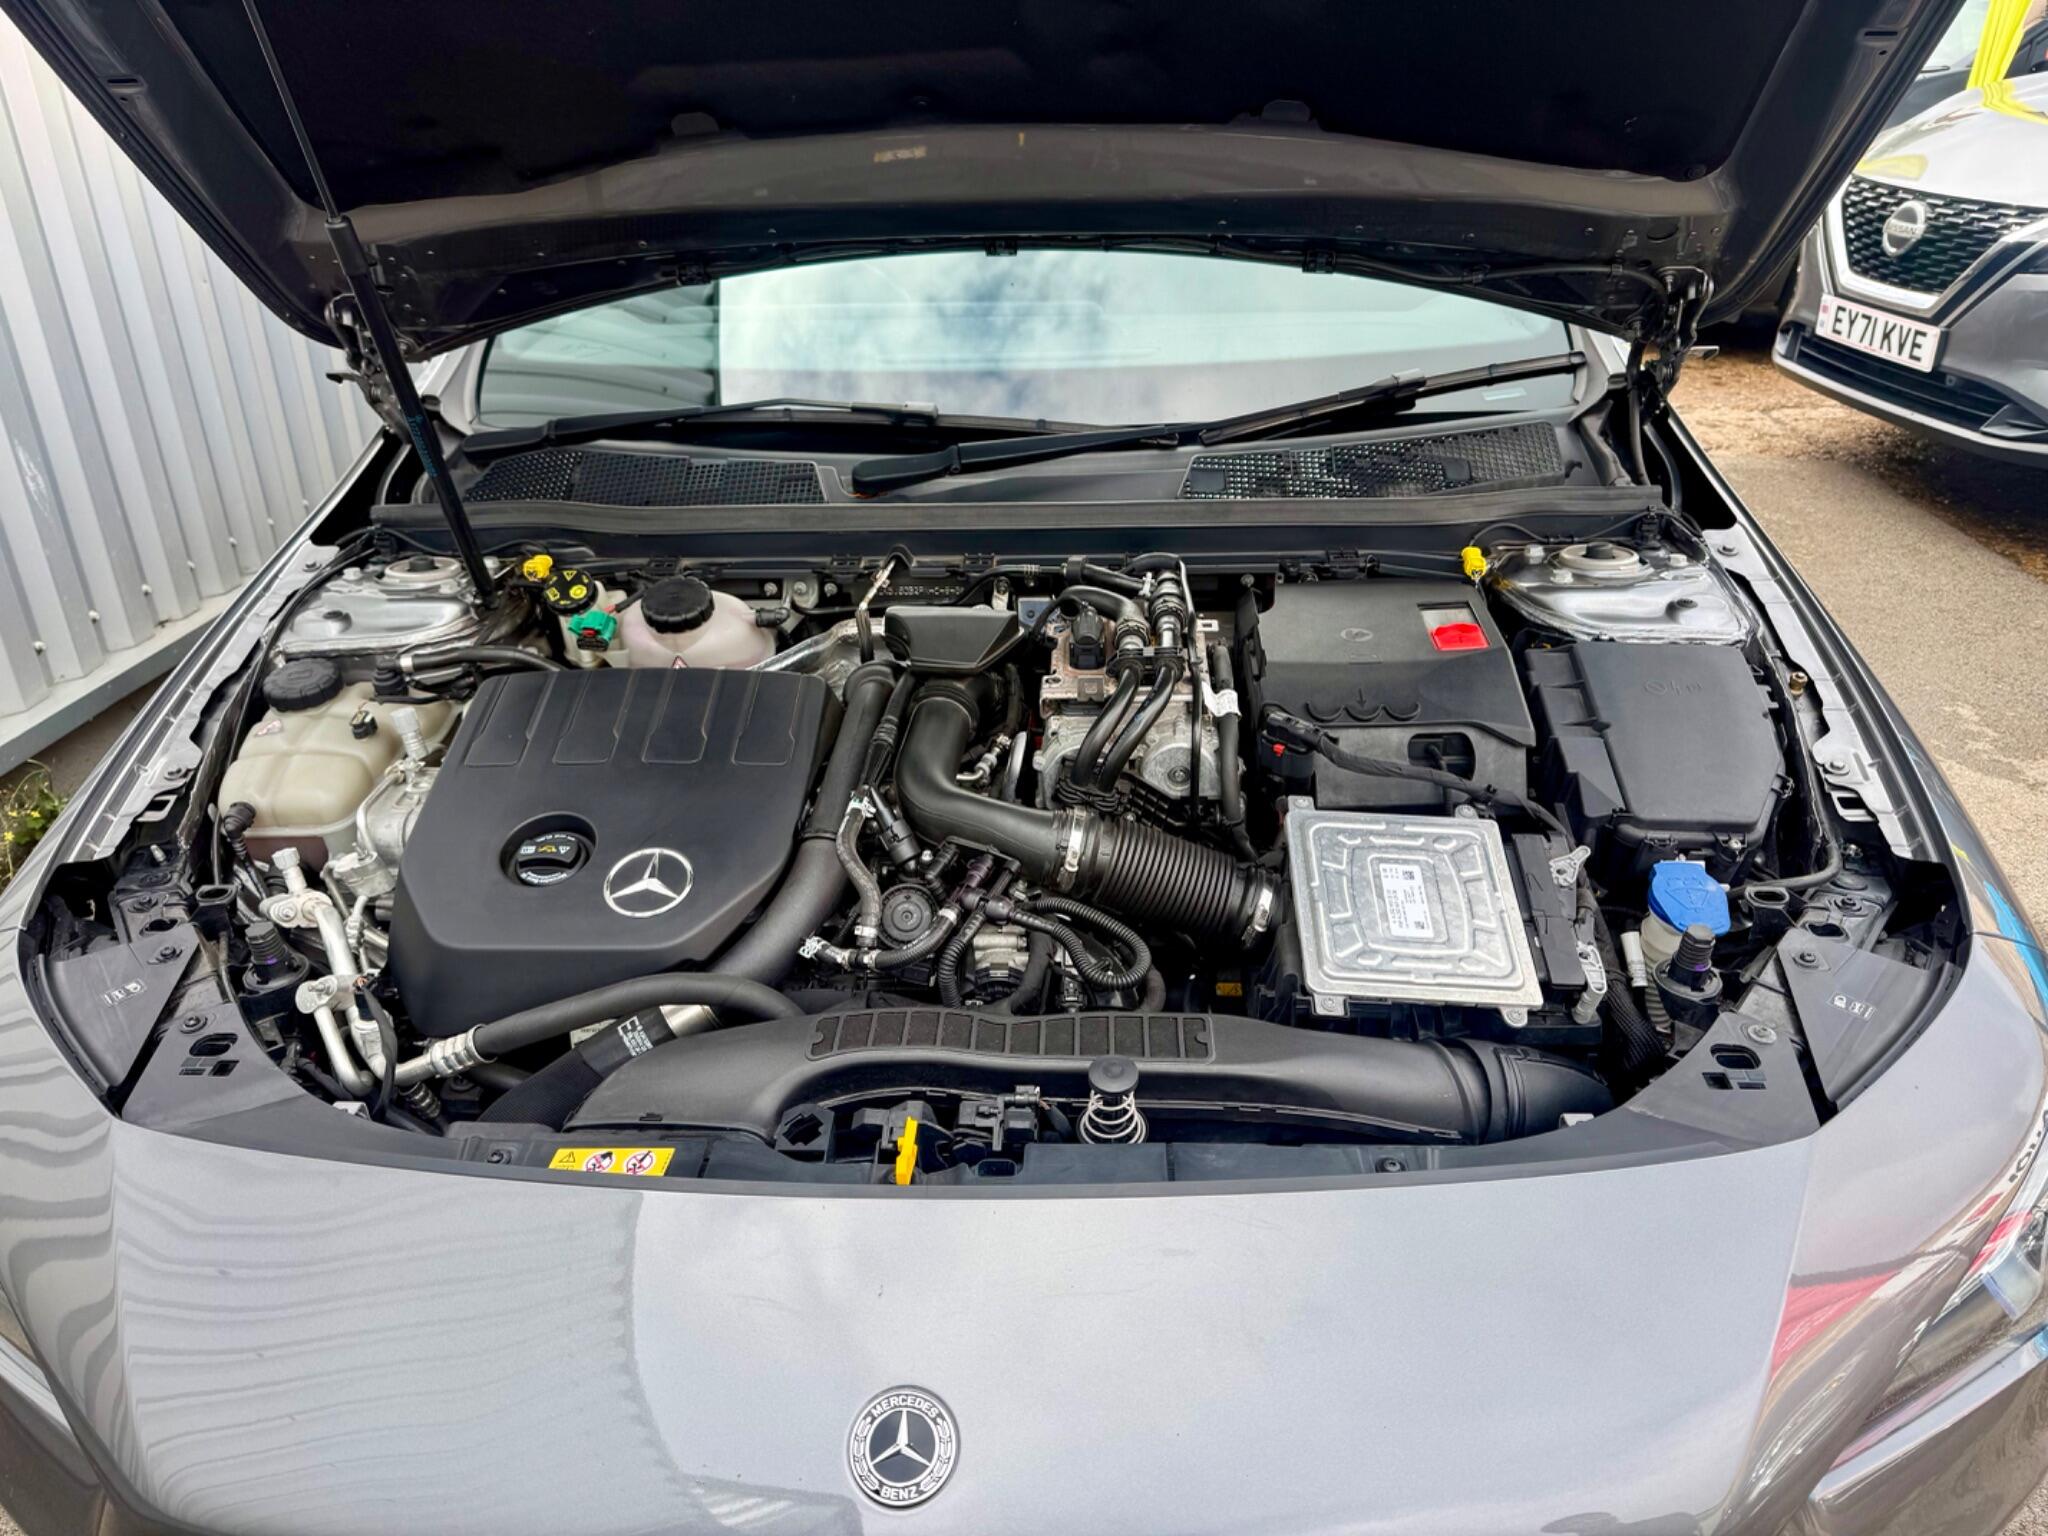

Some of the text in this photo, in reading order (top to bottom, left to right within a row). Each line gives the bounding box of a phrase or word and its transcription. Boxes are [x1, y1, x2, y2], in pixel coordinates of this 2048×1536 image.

[1832, 306, 1928, 362] EY71 KVE
[872, 1394, 939, 1418] MERCEDES
[880, 1486, 919, 1500] BENZ
